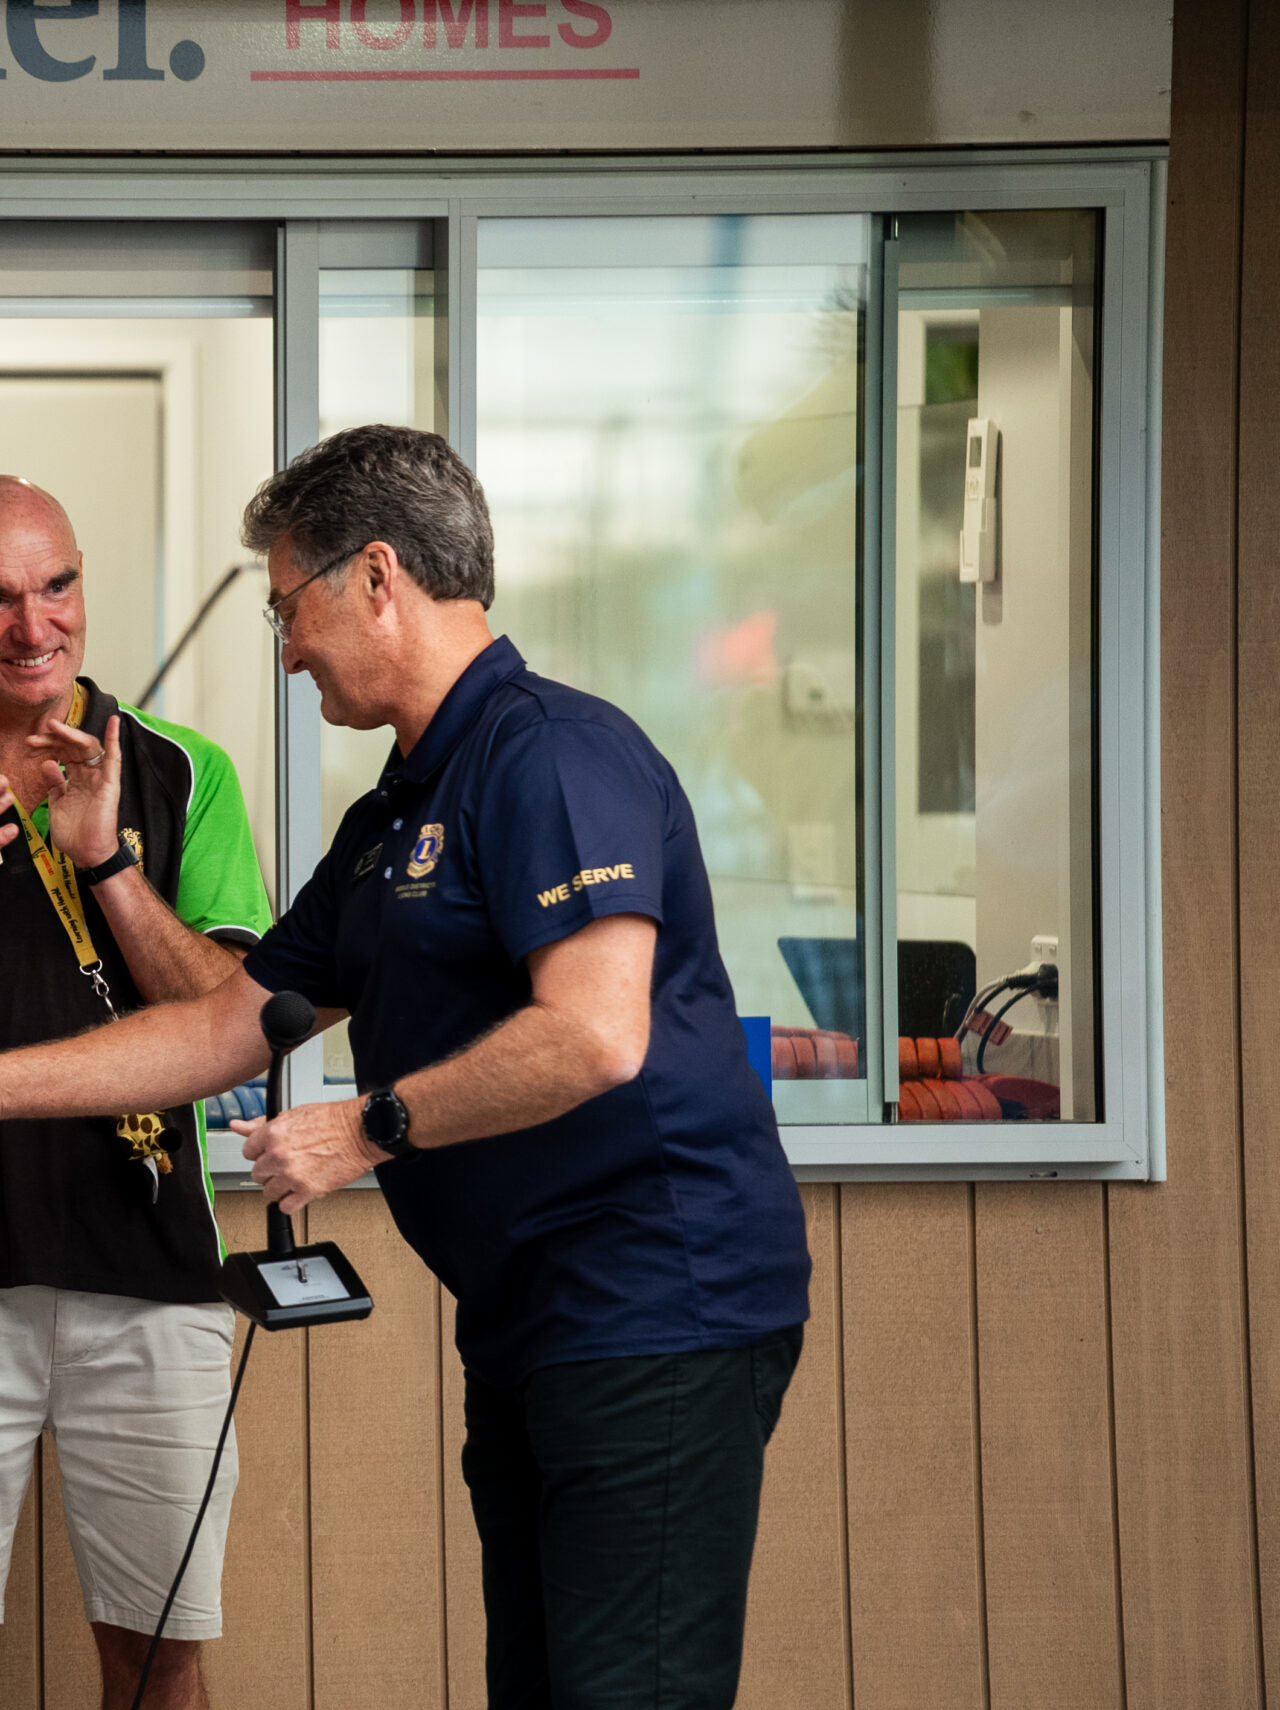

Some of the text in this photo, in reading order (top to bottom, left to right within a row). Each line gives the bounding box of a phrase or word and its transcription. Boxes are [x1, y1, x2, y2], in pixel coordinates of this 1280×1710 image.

[285, 0, 613, 50] HOMES
[536, 863, 635, 908] WE SERVE
